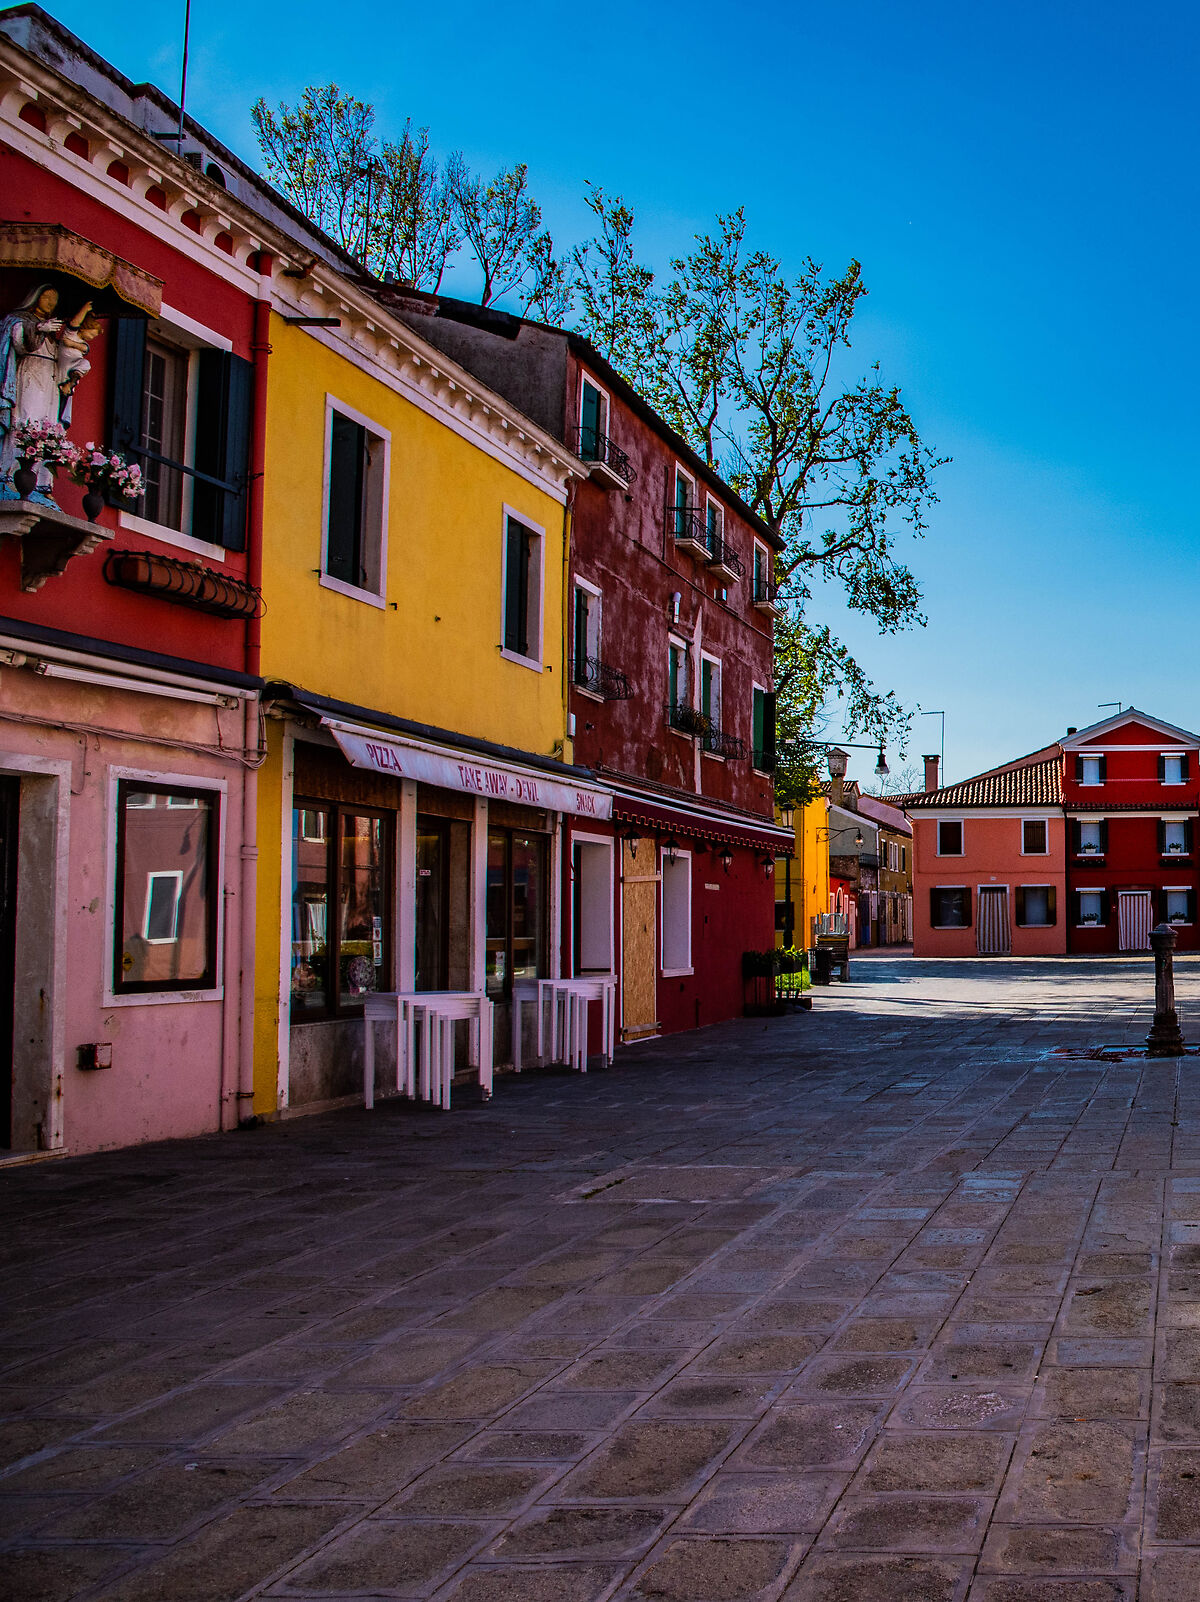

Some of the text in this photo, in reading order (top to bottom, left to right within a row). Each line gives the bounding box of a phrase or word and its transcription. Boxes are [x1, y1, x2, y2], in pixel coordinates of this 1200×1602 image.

[366, 743, 402, 771] PIZZA
[458, 765, 482, 791] TAKE
[485, 772, 507, 795] AWAY
[576, 792, 595, 814] SNACK
